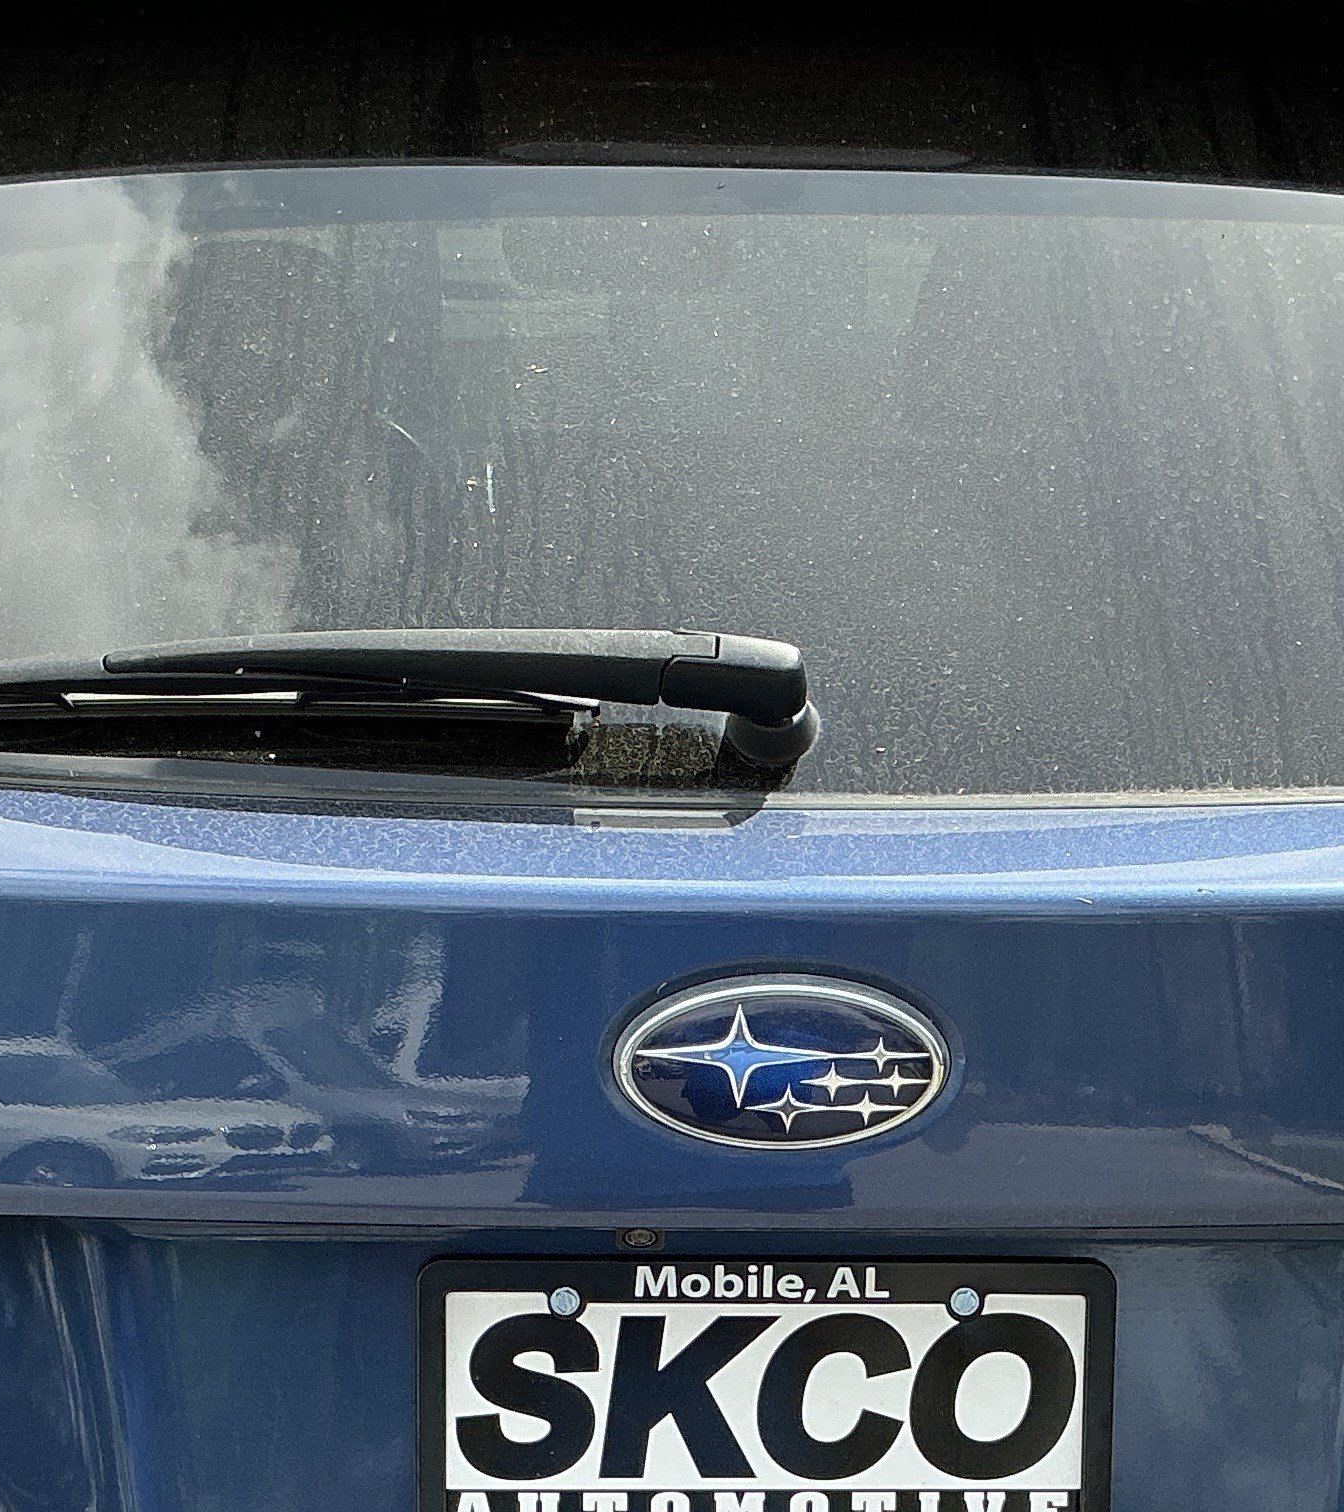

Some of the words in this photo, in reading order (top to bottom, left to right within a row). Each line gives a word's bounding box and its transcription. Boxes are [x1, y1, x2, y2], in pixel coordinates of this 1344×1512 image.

[634, 1264, 817, 1305] Mobile,
[826, 1266, 890, 1299] AL
[455, 1311, 1078, 1481] SKCO
